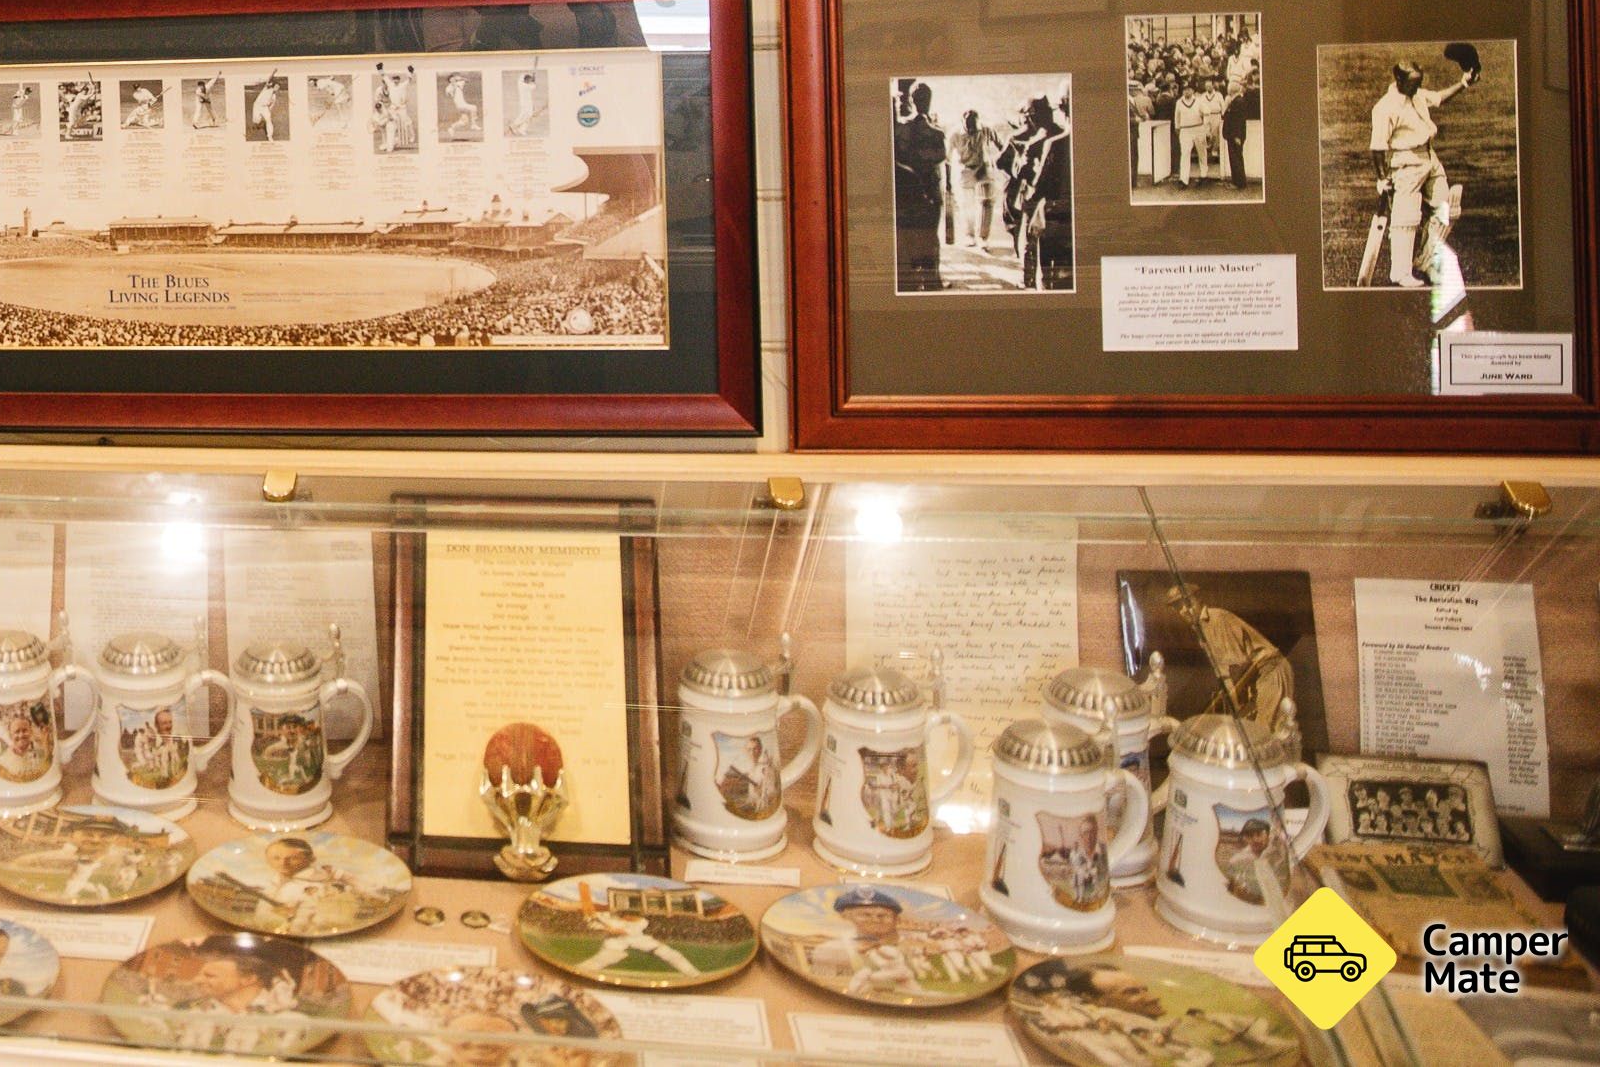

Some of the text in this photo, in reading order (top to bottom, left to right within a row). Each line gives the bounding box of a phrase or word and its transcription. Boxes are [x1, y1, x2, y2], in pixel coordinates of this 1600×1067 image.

[1134, 262, 1262, 275] "Farewell Little Master"
[128, 274, 210, 289] THE BLUES
[109, 289, 159, 303] LIVING
[165, 289, 230, 303] LEGENDS
[1480, 372, 1533, 380] JUNE WARD
[446, 544, 601, 556] DON BRADMAN MEMENTO
[1429, 583, 1461, 593] CRICKET
[1415, 595, 1479, 606] The Australian Way
[1361, 641, 1387, 649] Foreword
[1388, 642, 1396, 650] by
[1405, 643, 1425, 651] Donald
